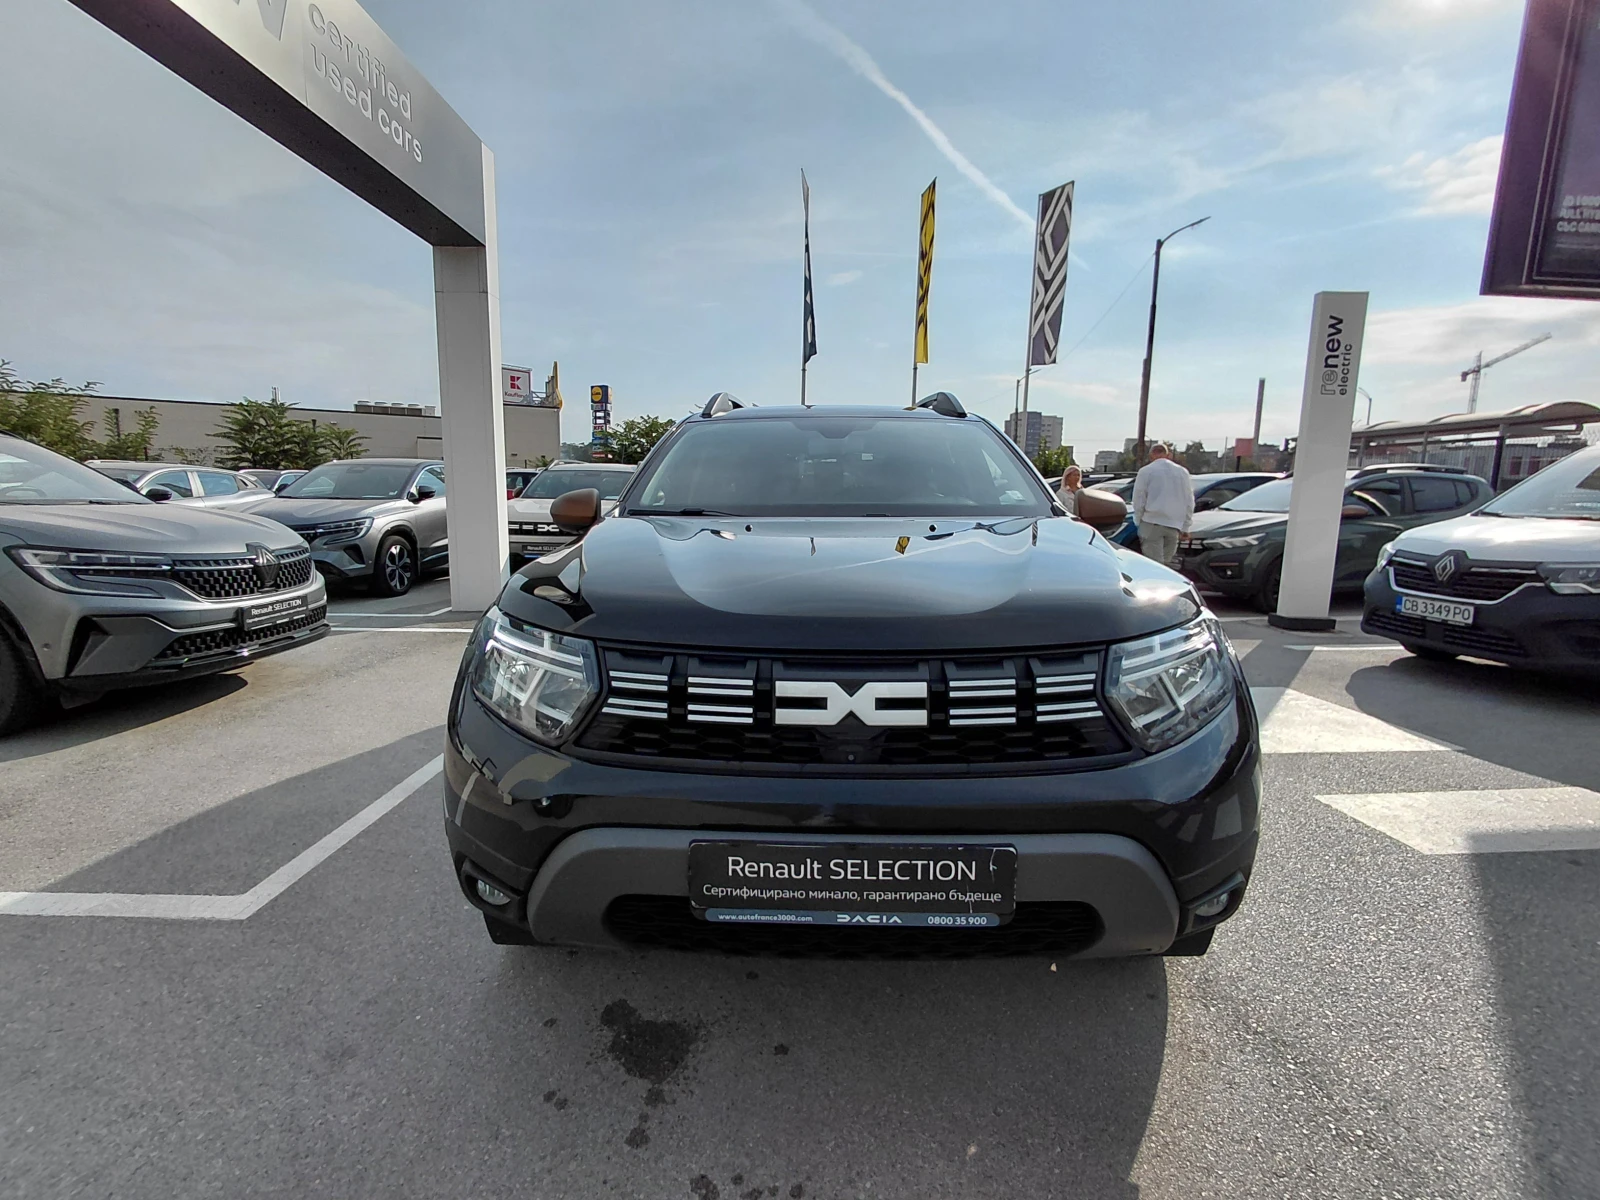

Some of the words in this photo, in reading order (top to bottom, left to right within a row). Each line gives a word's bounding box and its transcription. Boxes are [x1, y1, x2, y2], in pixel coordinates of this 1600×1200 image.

[308, 3, 412, 122] certified
[310, 43, 373, 121] used
[378, 108, 423, 163] cars
[1320, 314, 1344, 396] renew
[1338, 343, 1353, 396] electric
[251, 605, 273, 615] Renault
[273, 599, 301, 610] SELECTION
[1403, 599, 1419, 612] CB
[1420, 601, 1451, 618] 3349
[1452, 606, 1471, 621] PO
[727, 856, 822, 880] Renault
[829, 859, 976, 881] SELECTION
[703, 884, 806, 900] Сертифицирано
[809, 889, 861, 901] минало,
[863, 891, 946, 903] гарантирано
[949, 889, 1002, 903] бъдеще
[718, 913, 813, 922] www.autofrance3000.com
[836, 914, 902, 924] DACIA
[927, 916, 953, 925] 0800
[954, 916, 967, 925] 35
[968, 916, 987, 926] 900
